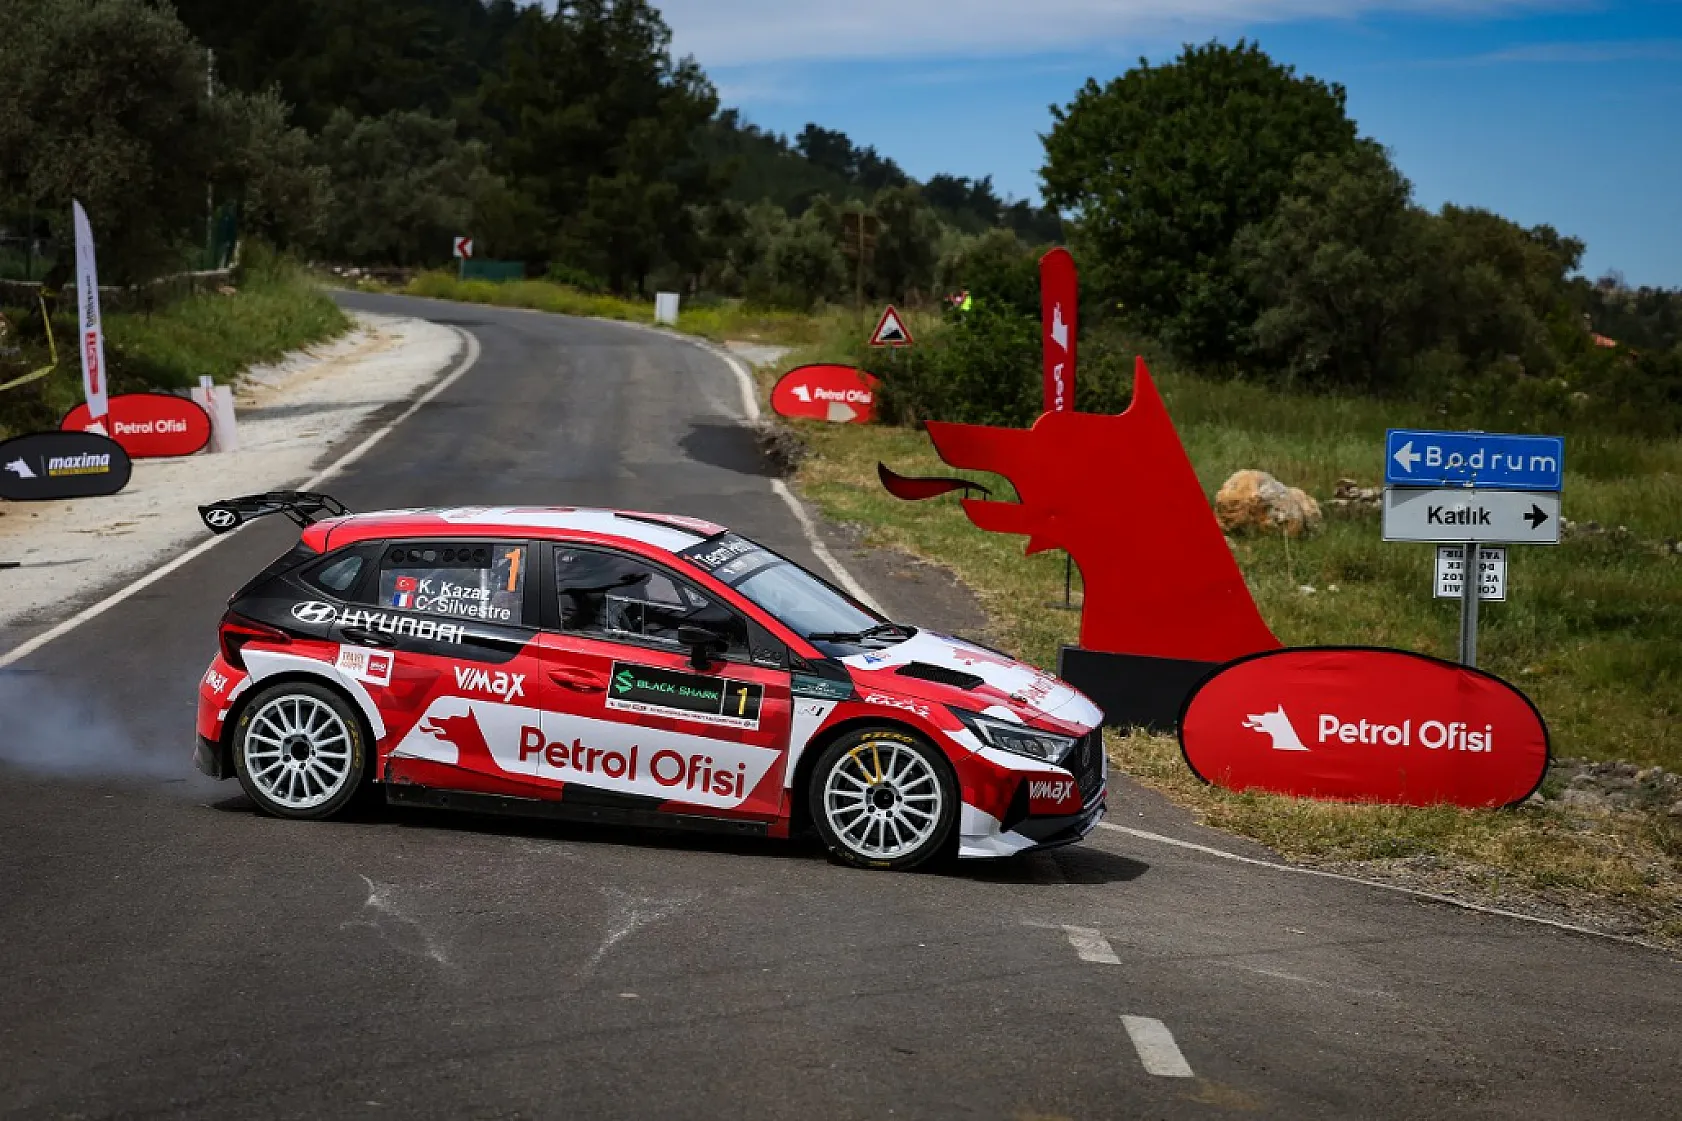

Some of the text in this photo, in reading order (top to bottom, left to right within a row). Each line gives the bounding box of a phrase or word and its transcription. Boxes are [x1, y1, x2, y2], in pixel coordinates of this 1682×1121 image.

[114, 418, 187, 435] Petrol Ofisi
[49, 452, 110, 469] maxima
[1426, 445, 1557, 472] Bodrum
[1427, 505, 1491, 525] Katlık
[505, 548, 520, 592] 1
[419, 579, 491, 601] K. Kazaz
[416, 595, 511, 620] C. Silvestre
[338, 608, 465, 645] HYUNDAI
[637, 680, 719, 700] BLACK SHARK
[737, 687, 748, 716] 1
[1318, 714, 1493, 752] Petrol Ofisi
[519, 725, 746, 800] Petrol Ofisi
